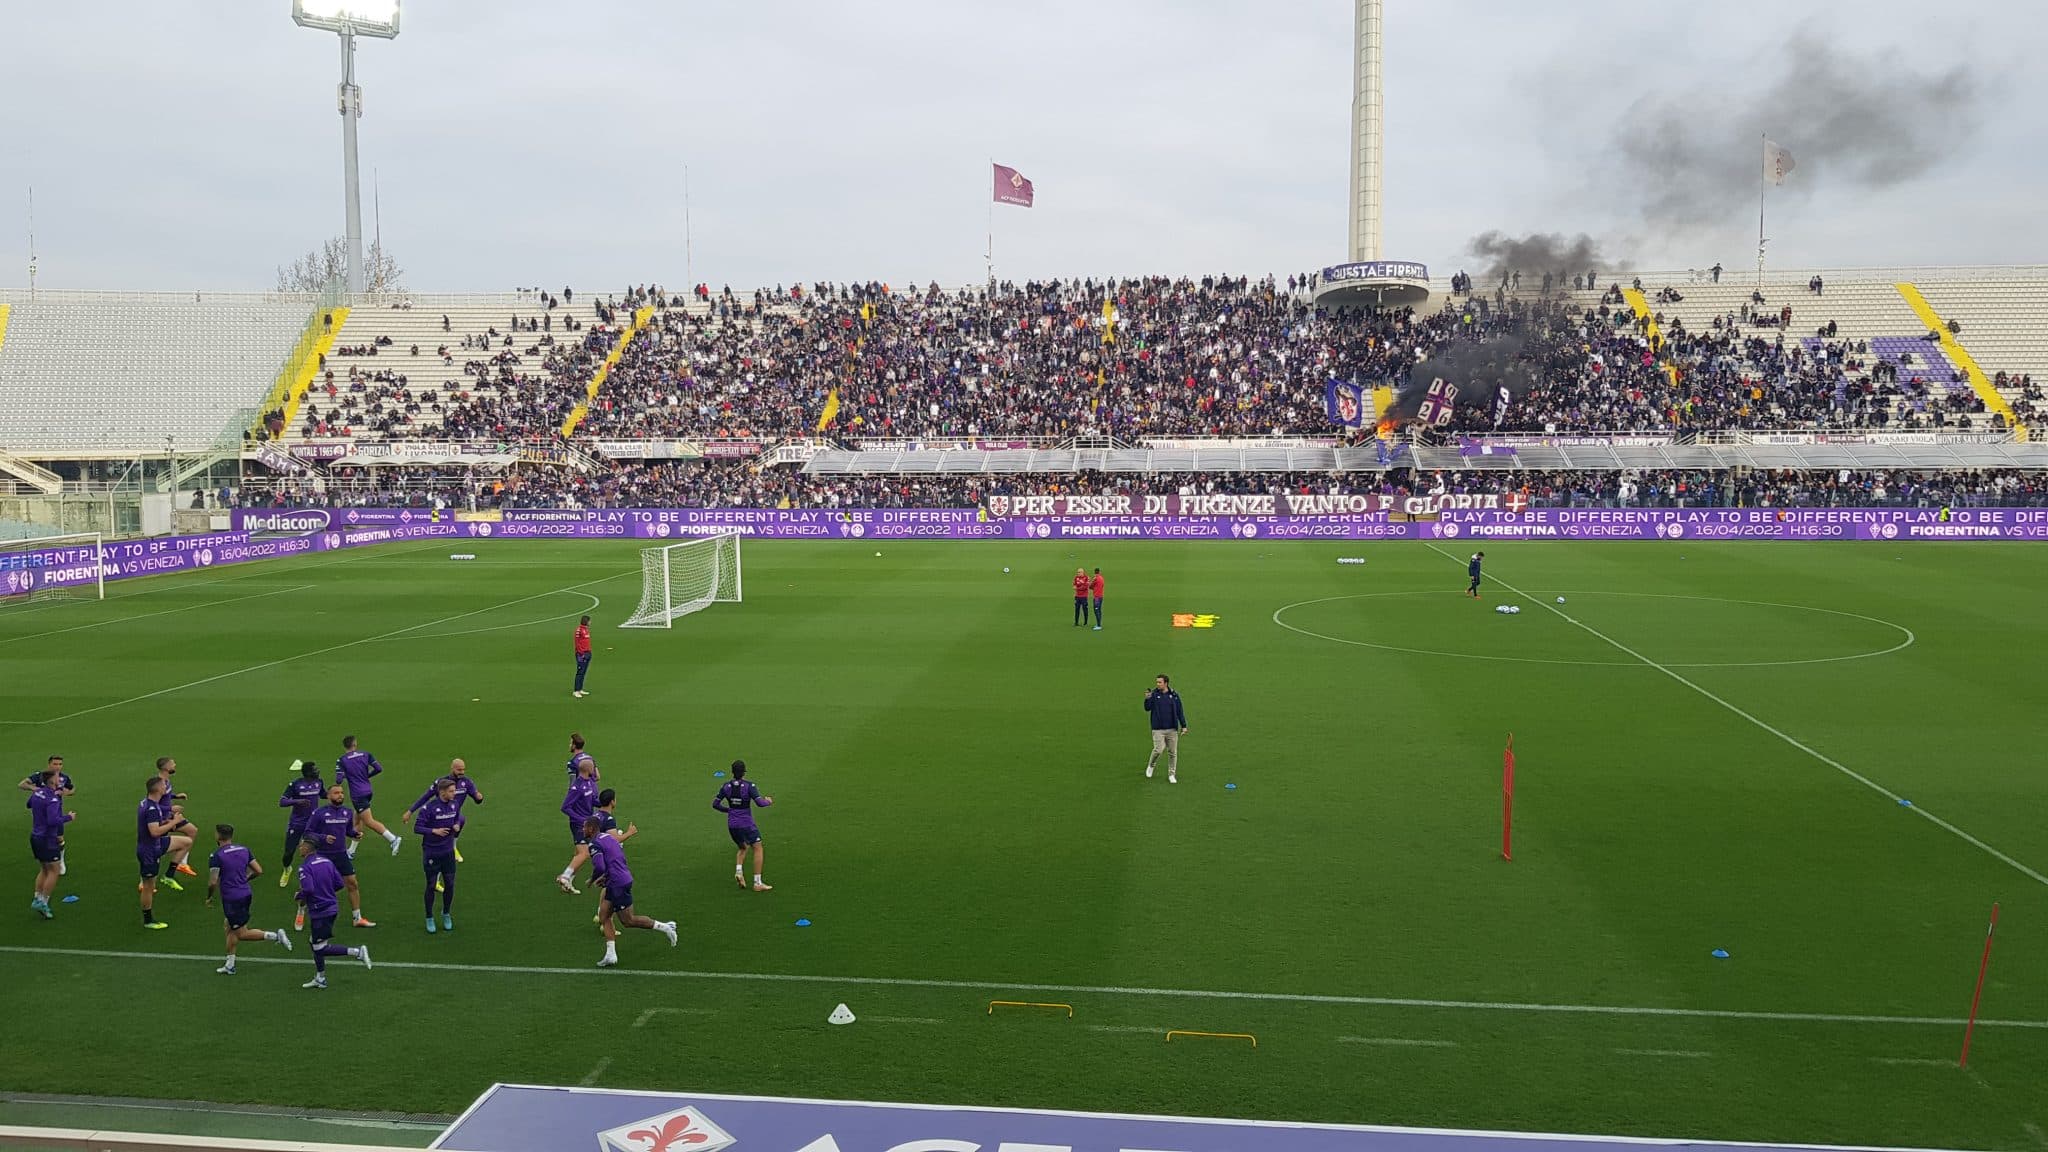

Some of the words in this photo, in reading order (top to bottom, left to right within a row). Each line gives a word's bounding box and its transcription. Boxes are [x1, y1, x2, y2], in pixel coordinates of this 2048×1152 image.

[1334, 265, 1377, 279] QUESTA
[358, 446, 391, 457] GORIZIA
[521, 448, 567, 464] PUGLIA
[1012, 495, 1055, 515] PER
[1066, 495, 1132, 515] ESSER
[1143, 495, 1168, 515] DI
[1179, 495, 1275, 515] FIRENZE
[1285, 495, 1367, 514] VANTO
[1404, 494, 1498, 515] GLORIA
[243, 514, 322, 531] Mediacom
[588, 512, 626, 522] PLAY
[633, 512, 652, 522] TO
[659, 512, 679, 522] BE
[690, 512, 776, 522] DIFFERENT
[780, 512, 819, 522] PLAY
[853, 512, 873, 522] BE
[884, 512, 972, 522] DIFFERENT
[1441, 512, 1487, 522] PLAY
[1494, 512, 1516, 522] TO
[1525, 512, 1547, 522] BE
[1560, 512, 1660, 522] DIFFERENT
[1664, 512, 1710, 522] PLAY
[1718, 512, 1741, 522] TO
[1750, 512, 1773, 522] BE
[1786, 512, 1889, 522] DIFFERENT
[1893, 512, 1939, 522] PLAY
[1948, 512, 1971, 522] TO
[1979, 512, 2003, 522] BE
[346, 530, 391, 544] FIORENTINA
[392, 528, 404, 538] VS
[407, 525, 457, 536] VENEZIA
[502, 524, 575, 535] 16/04/2022
[581, 524, 624, 535] H16:30
[681, 525, 755, 535] FIORENTINA
[758, 525, 774, 535] VS
[777, 525, 829, 535] VENEZIA
[875, 525, 951, 535] 16/04/2022
[957, 525, 1003, 535] H16:30
[1062, 525, 1140, 535] FIORENTINA
[1144, 525, 1161, 535] VS
[1164, 525, 1219, 535] VENEZIA
[1268, 525, 1350, 535] 16/04/2022
[1358, 525, 1406, 535] H16:30
[1471, 525, 1557, 536] FIORENTINA
[1561, 525, 1579, 535] VS
[1582, 525, 1642, 535] VENEZIA
[1696, 525, 1783, 536] 16/04/2022
[1790, 525, 1842, 535] H16:30
[1910, 526, 2000, 536] FIORENTINA
[2004, 526, 2023, 536] VS
[125, 543, 143, 557] TO
[150, 541, 167, 553] BE
[220, 543, 275, 561] 16/04/2022
[279, 539, 310, 553] H16:30
[44, 563, 120, 583] FIORENTNA
[123, 559, 137, 573] VS
[141, 555, 184, 570] VENEZIA
